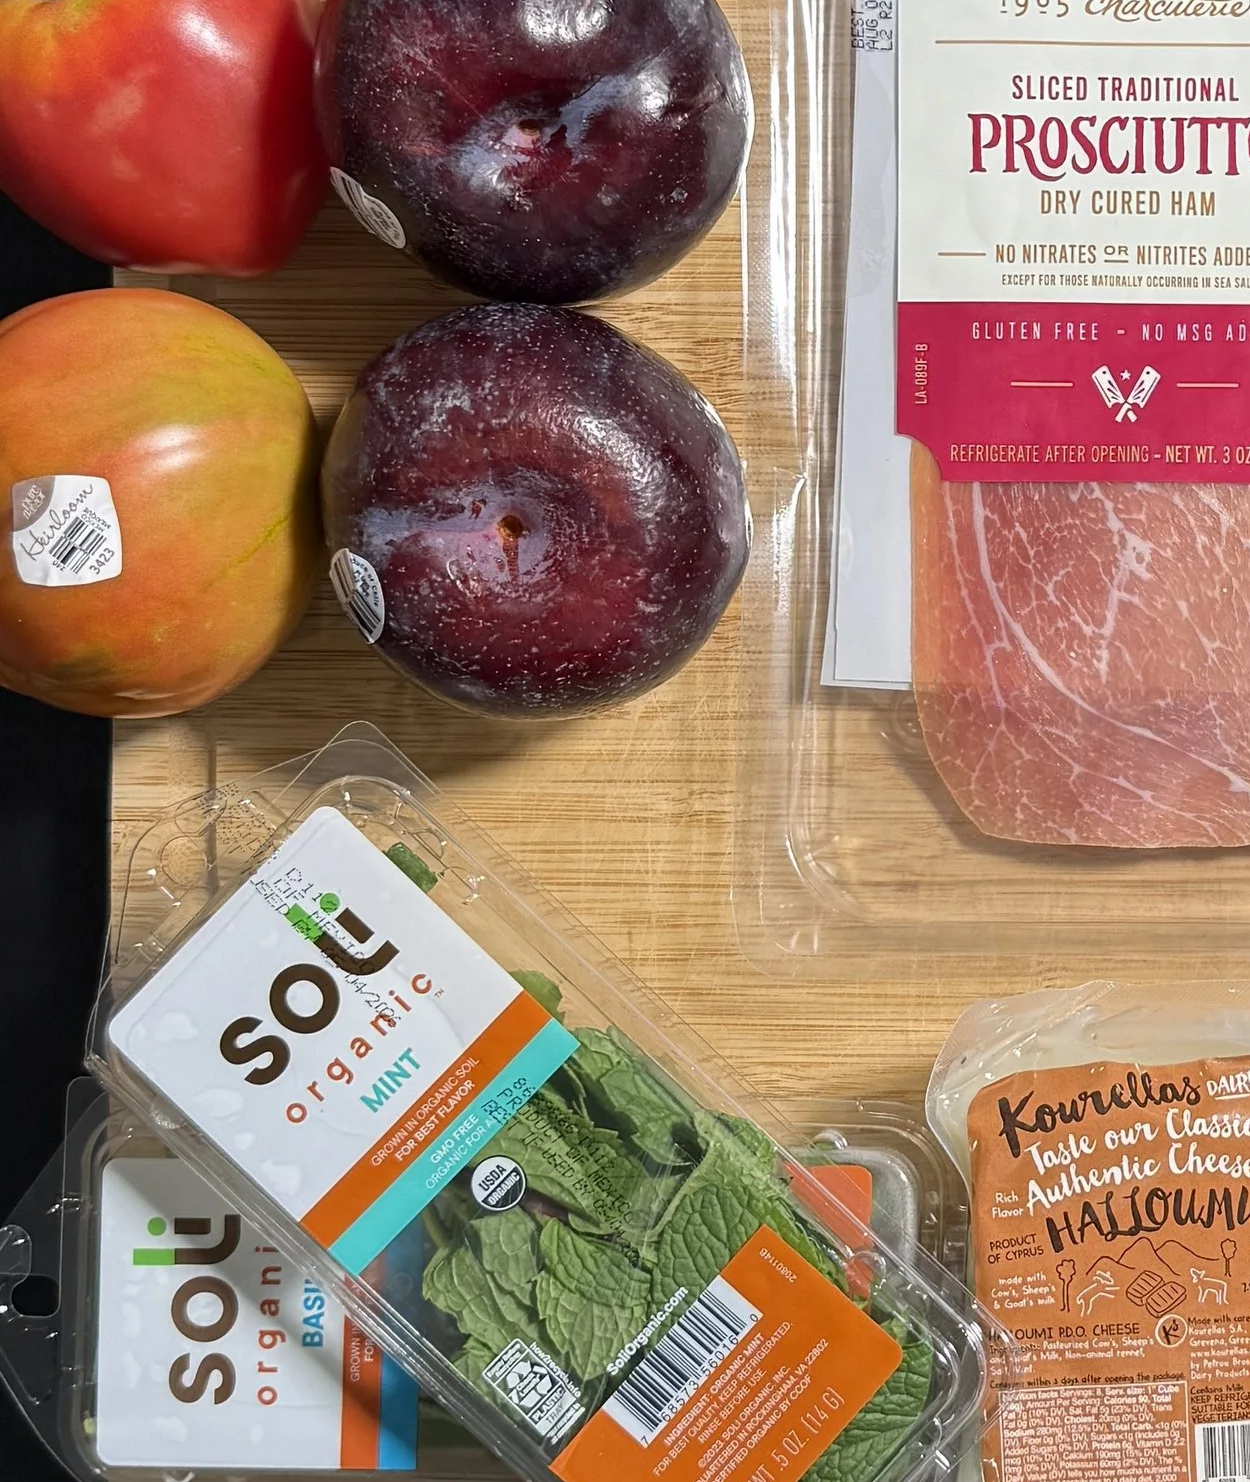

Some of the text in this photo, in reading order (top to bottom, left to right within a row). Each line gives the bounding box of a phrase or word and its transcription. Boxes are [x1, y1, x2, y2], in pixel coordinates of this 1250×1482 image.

[850, 8, 864, 48] BEST
[864, 18, 878, 49] AUG
[1012, 75, 1239, 102] SLICED TRADITIONAL
[1040, 190, 1216, 217] DRY CURED HAM
[995, 244, 1016, 264] NO
[1021, 244, 1097, 265] NITRATES
[1104, 245, 1129, 257] OR
[1136, 245, 1208, 266] NITRITES
[1002, 274, 1035, 287] EXCEPT
[1038, 274, 1056, 287] FOR
[1059, 274, 1089, 287] THOSE
[1092, 275, 1144, 288] NATURALLY
[1146, 275, 1198, 288] OCCURRING
[1200, 276, 1211, 288] IN
[1214, 276, 1231, 288] SEA
[972, 322, 1042, 341] GLUTEN
[1054, 323, 1100, 341] FREE
[1141, 323, 1165, 342] NO
[1176, 323, 1213, 343] MSG
[914, 342, 928, 405] LA-089F-B
[950, 444, 1040, 463] REFRIGERATE
[1045, 445, 1085, 463] AFTER
[1092, 445, 1149, 464] OPENING
[1165, 445, 1191, 464] NET
[1195, 445, 1218, 465] WT.
[1222, 445, 1230, 465] 3
[21, 481, 95, 561] Heirloom
[88, 545, 115, 575] 3423
[285, 972, 434, 1124] organic
[360, 1047, 423, 1114] MINT
[394, 1077, 476, 1163] FOR BEST FLAVOR
[999, 1070, 1201, 1158] Kourellas
[1024, 1133, 1097, 1174] Taste
[1105, 1123, 1159, 1151] our
[477, 1162, 507, 1192] USDA
[1025, 1157, 1160, 1218] Authentic
[987, 1245, 1044, 1264] OF CYPRUS
[989, 1234, 1037, 1250] PRODUCT
[255, 1245, 285, 1405] organi
[302, 1278, 325, 1347] BASI
[602, 1283, 692, 1377] SoliOrganic.com
[766, 1448, 791, 1472] .5
[782, 1425, 811, 1454] OZ.
[799, 1402, 831, 1435] (14
[818, 1384, 847, 1412] G)
